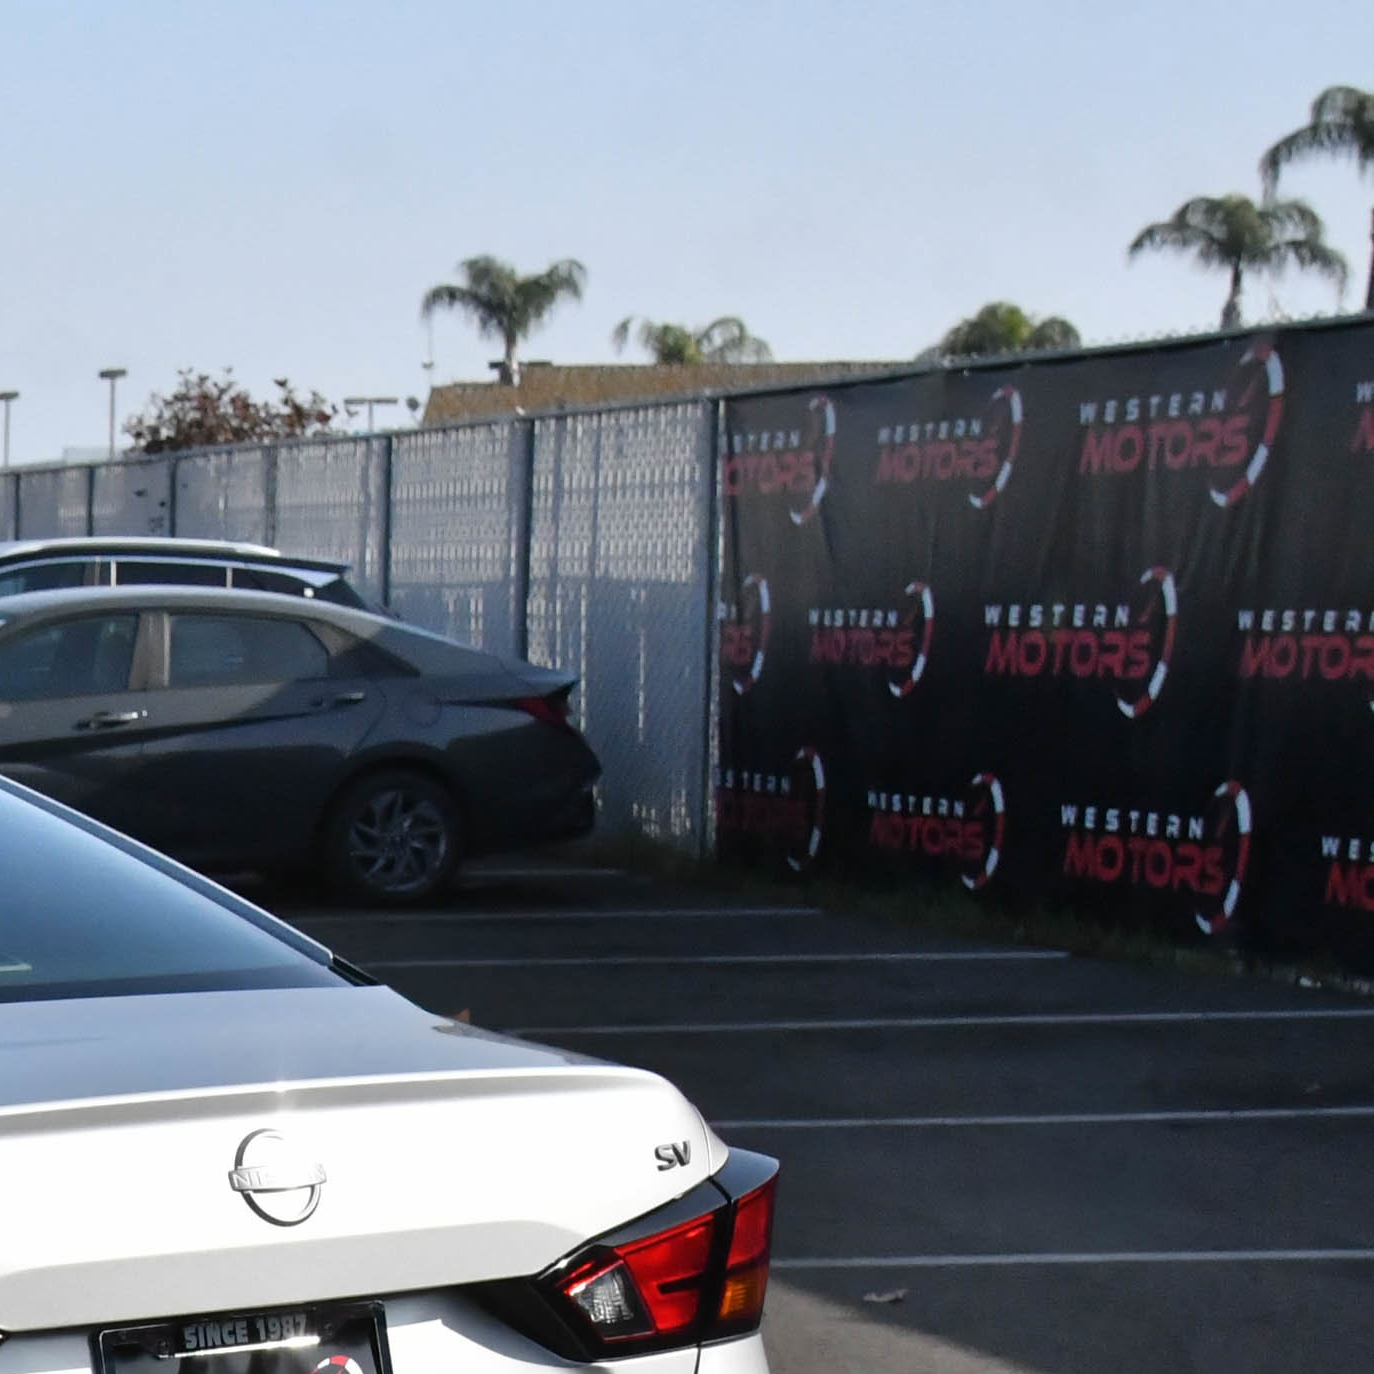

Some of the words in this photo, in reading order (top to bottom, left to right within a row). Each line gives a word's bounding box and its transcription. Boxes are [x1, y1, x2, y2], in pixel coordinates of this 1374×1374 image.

[1080, 390, 1227, 425] WESTERN
[877, 419, 982, 445] WESTERN
[1079, 415, 1249, 473] MOTORS
[876, 438, 999, 482] MOTORS
[809, 608, 898, 628] WESTERN
[985, 604, 1130, 628] WESTERN
[810, 628, 915, 666] MOTORS
[984, 630, 1151, 678] MOTORS
[868, 792, 965, 818] WESTERN
[1061, 804, 1204, 841] WESTERN
[870, 813, 984, 858] MOTORS
[1064, 834, 1225, 895] MOTORS
[654, 1140, 691, 1171] SV
[184, 1323, 250, 1350] SINCE
[254, 1314, 309, 1342] 1987
